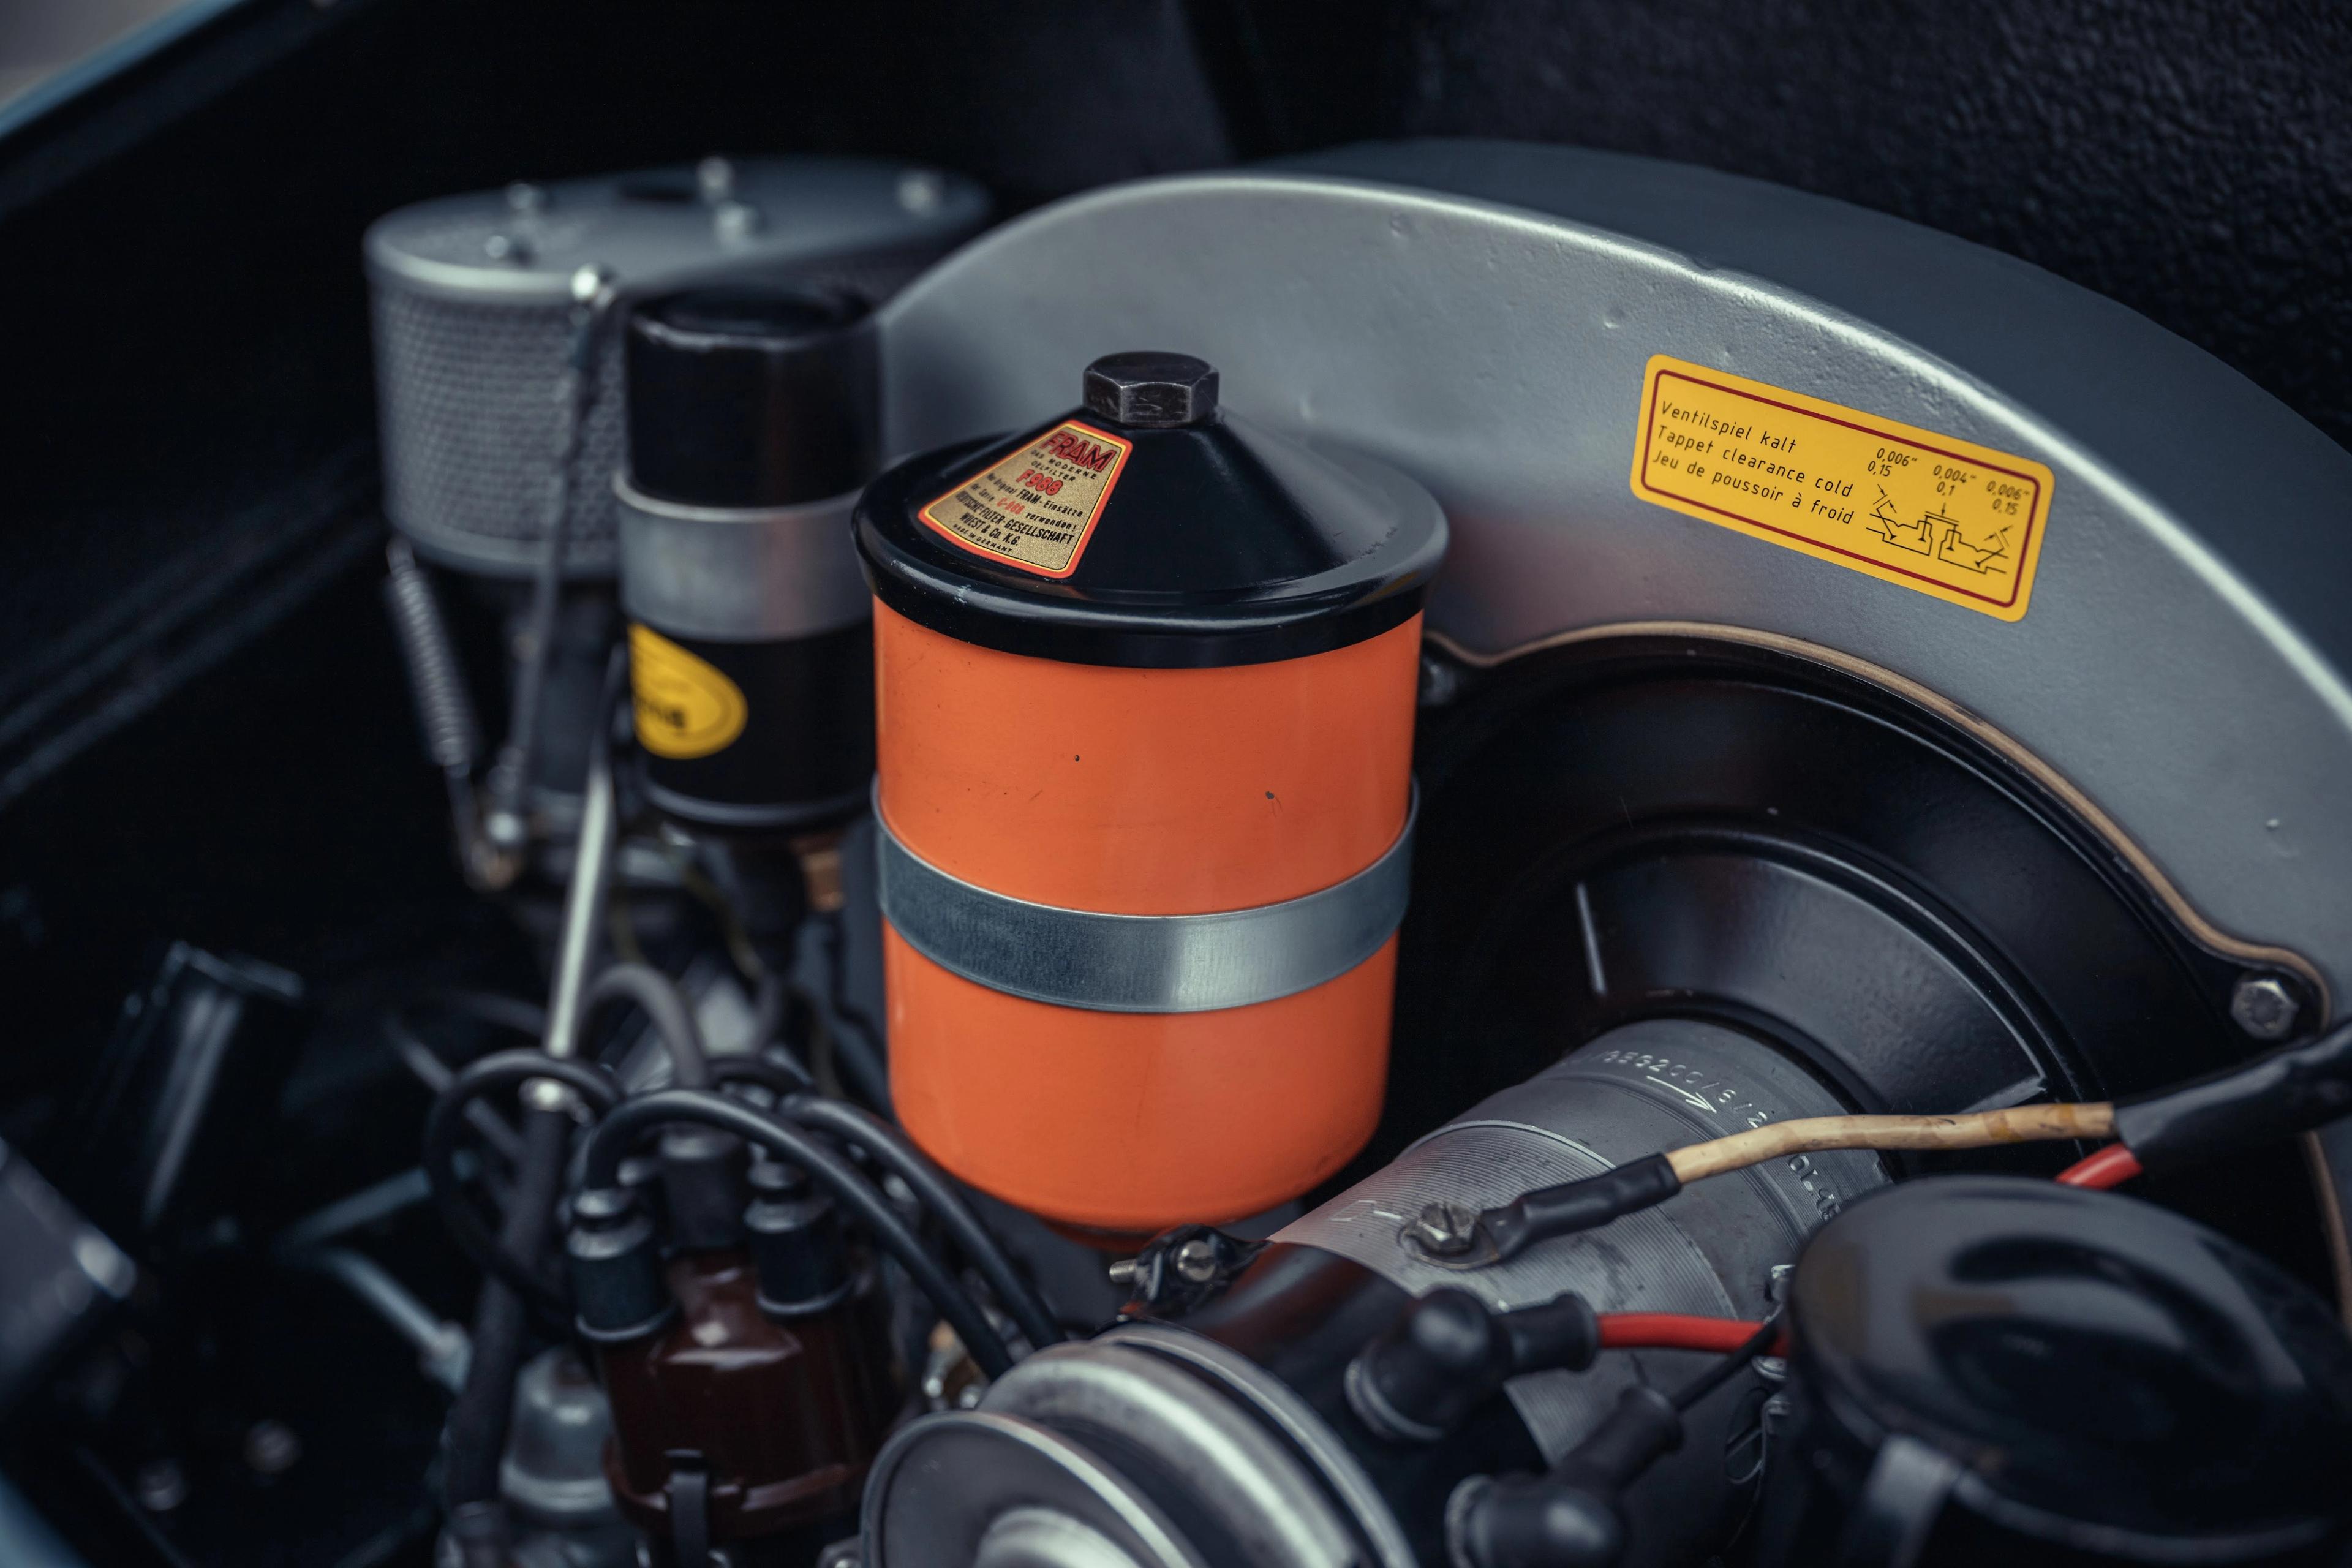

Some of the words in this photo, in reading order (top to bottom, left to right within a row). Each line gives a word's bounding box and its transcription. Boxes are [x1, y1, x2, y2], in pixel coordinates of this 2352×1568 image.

[1662, 400, 1752, 440] Ventilspiel
[1760, 431, 1796, 453] kalt
[1031, 449, 1045, 459] DAS
[1048, 458, 1098, 480] MODERNE
[1039, 431, 1117, 472] FRAM
[1658, 424, 1714, 454] Tappet
[1722, 448, 1805, 483] clearance
[1815, 480, 1853, 497] cold
[1016, 469, 1064, 496] F988
[1031, 461, 1076, 482] OELFILTER
[1868, 460, 1893, 477] 0,15
[1652, 450, 1679, 469] Jeu
[1686, 461, 1705, 477] de
[1711, 472, 1784, 501] poussoir
[1792, 492, 1803, 508] à
[1811, 499, 1855, 524] froid
[1936, 481, 1956, 496] 0,1
[952, 524, 969, 535] MADE
[976, 536, 1013, 552] GERMANY
[981, 524, 991, 534] &
